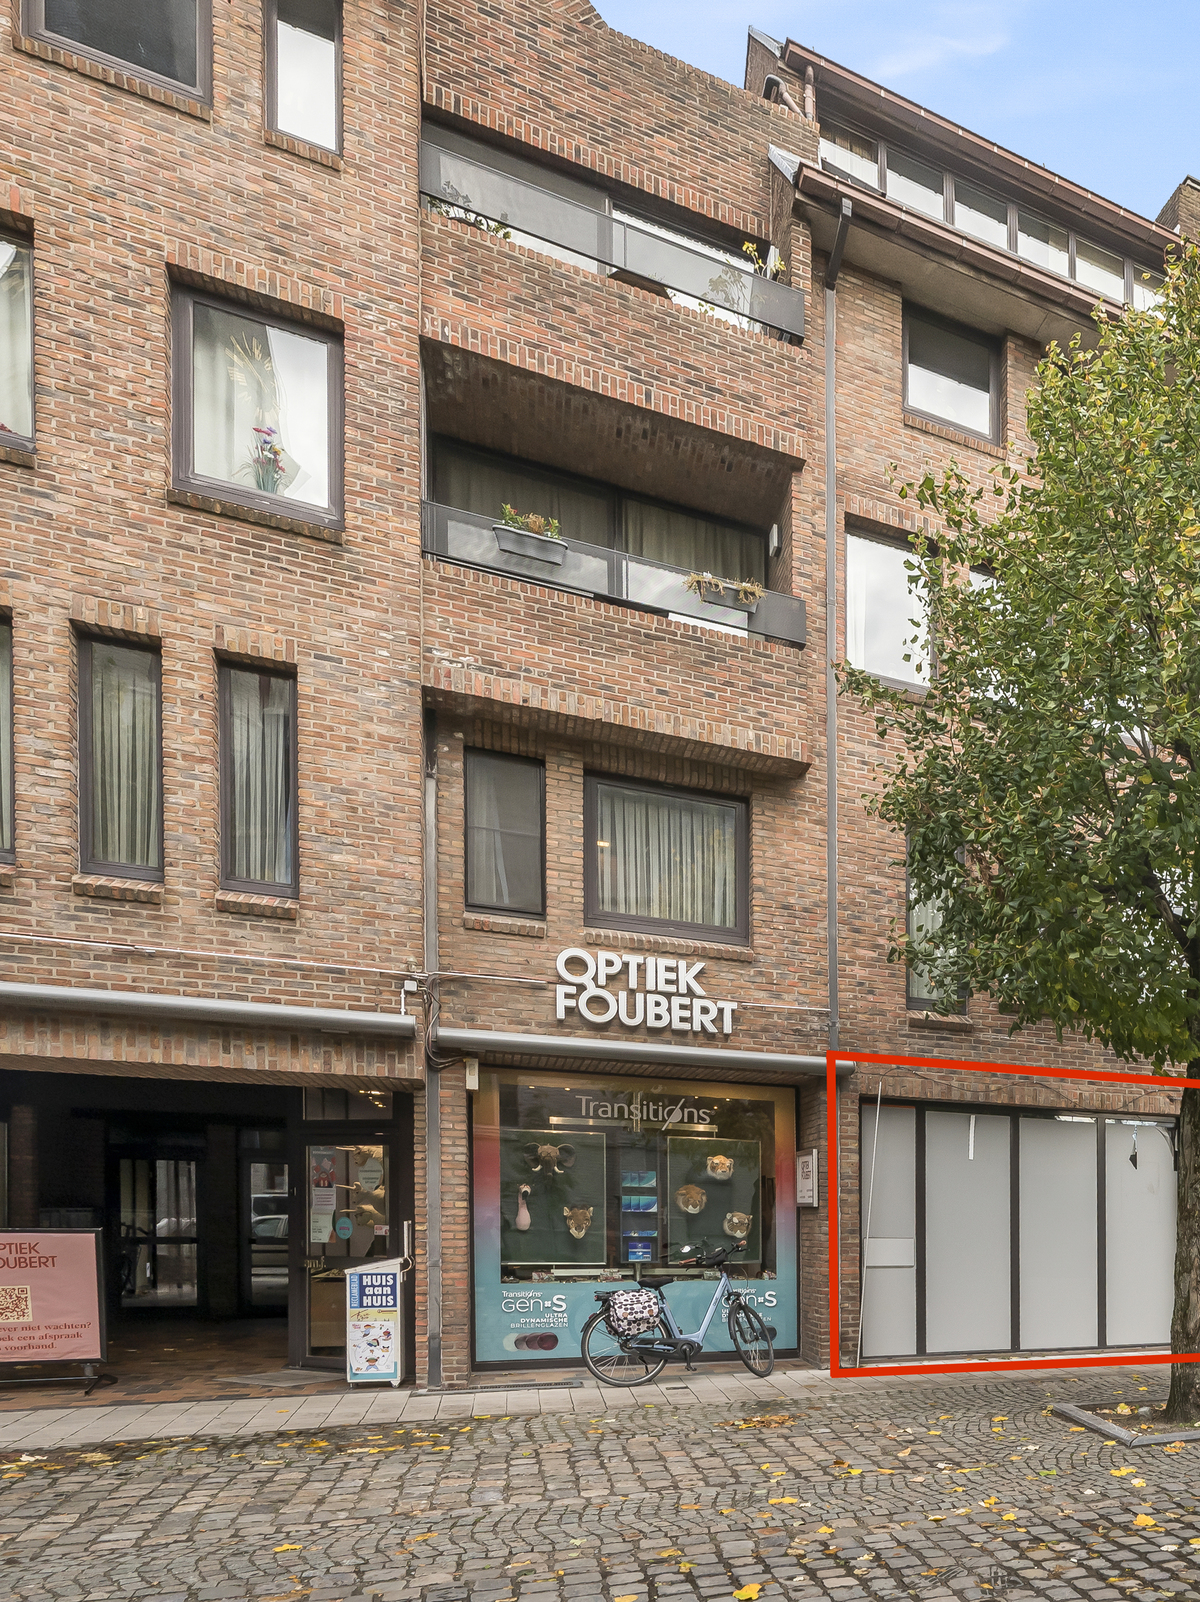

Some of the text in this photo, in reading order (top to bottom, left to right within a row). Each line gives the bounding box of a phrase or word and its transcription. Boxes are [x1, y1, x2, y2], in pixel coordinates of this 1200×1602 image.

[556, 947, 707, 997] OPTIEK
[556, 985, 738, 1035] FOUBERT
[575, 1095, 713, 1131] Transitions
[362, 1275, 394, 1286] HUIS
[365, 1286, 391, 1295] aan
[502, 1290, 542, 1299] Transitions
[362, 1296, 394, 1307] HUIS
[44, 1322, 92, 1330] wachten?
[39, 1332, 83, 1340] afspraak
[4, 1342, 57, 1351] voorhand.
